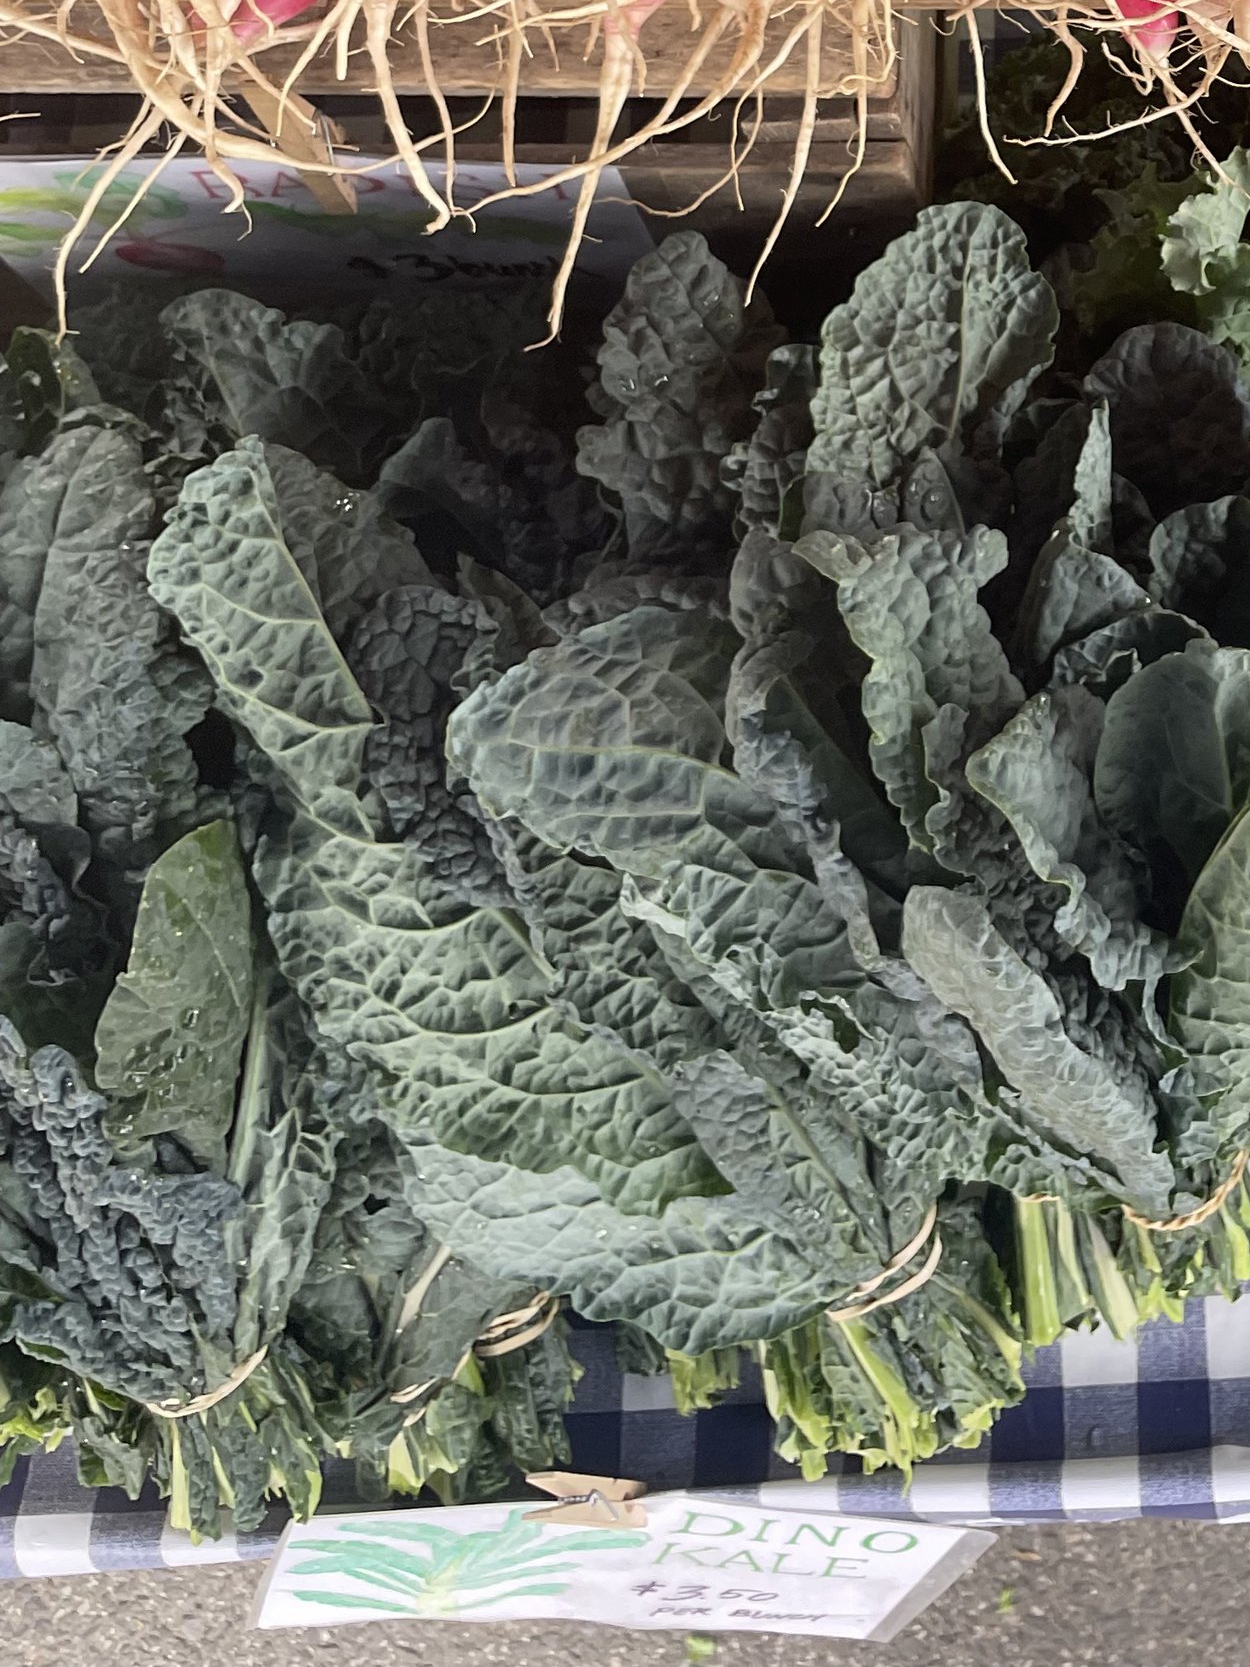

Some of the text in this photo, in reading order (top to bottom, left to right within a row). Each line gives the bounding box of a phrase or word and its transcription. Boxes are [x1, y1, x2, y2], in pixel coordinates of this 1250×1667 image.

[670, 1511, 919, 1553] DINO
[652, 1542, 869, 1579] KALE
[630, 1581, 779, 1601] $3.50
[649, 1606, 712, 1618] PER
